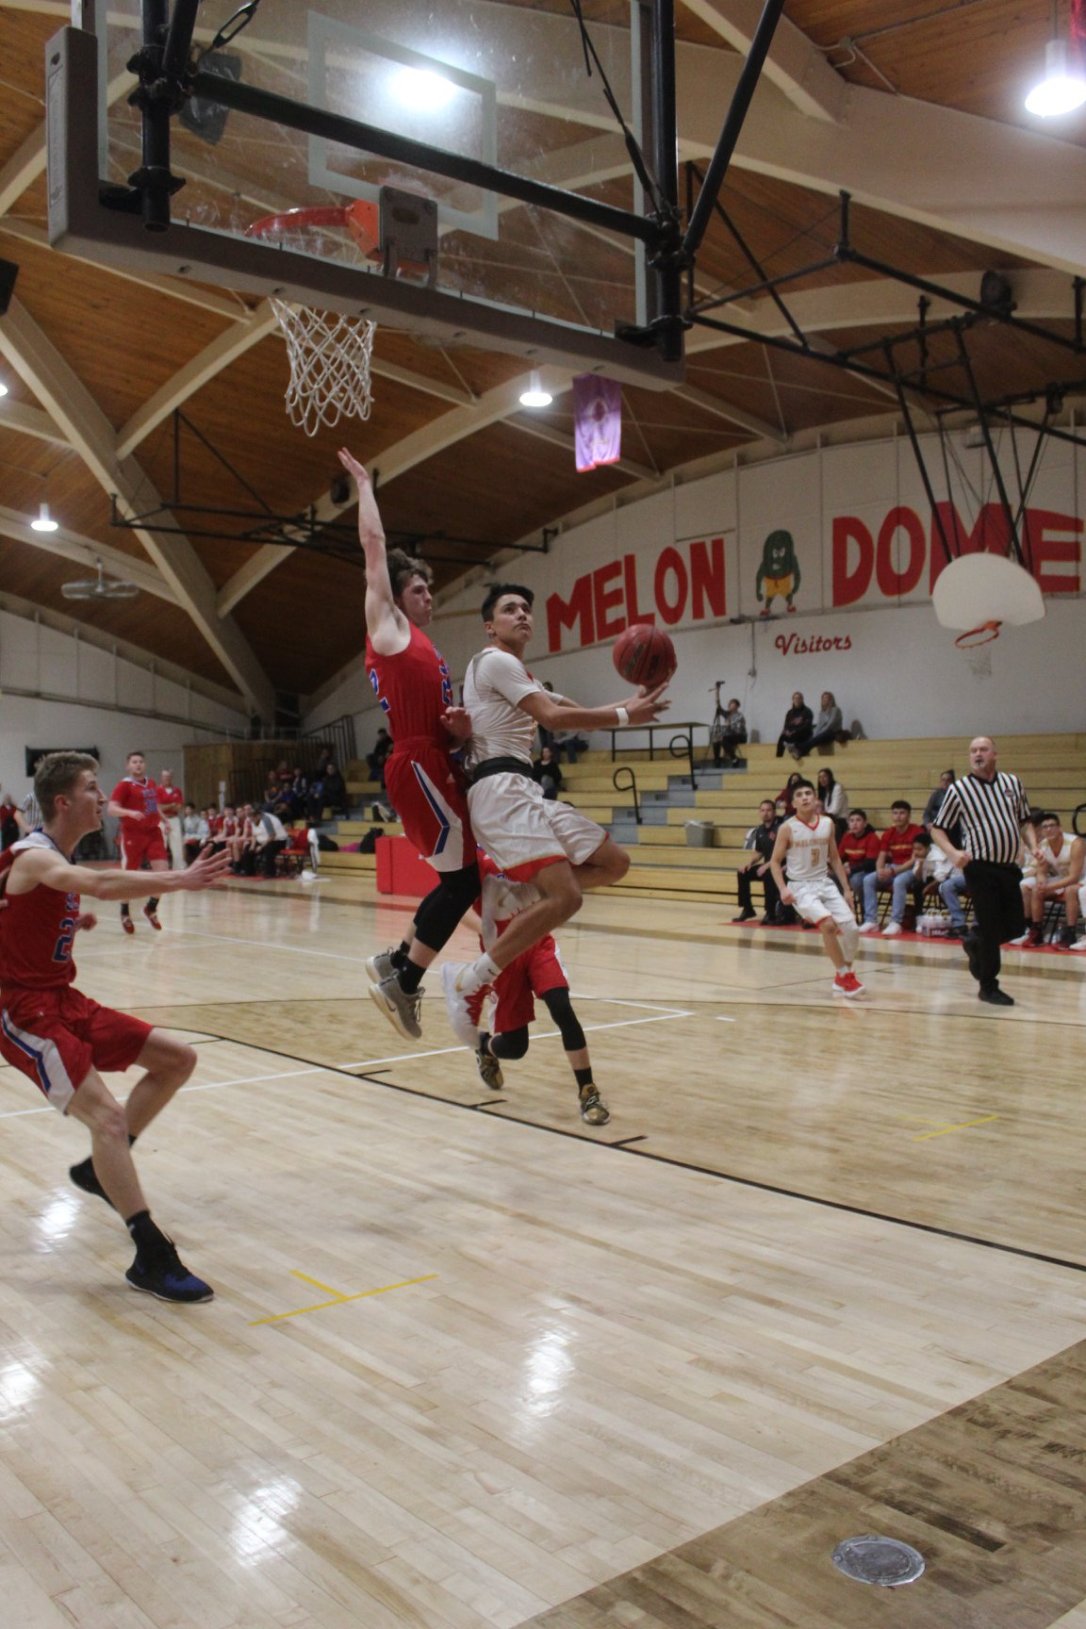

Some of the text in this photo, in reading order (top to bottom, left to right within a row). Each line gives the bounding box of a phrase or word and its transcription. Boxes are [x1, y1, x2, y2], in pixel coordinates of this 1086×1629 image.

[546, 500, 1085, 653] MELON DOME
[775, 633, 852, 656] Visitors
